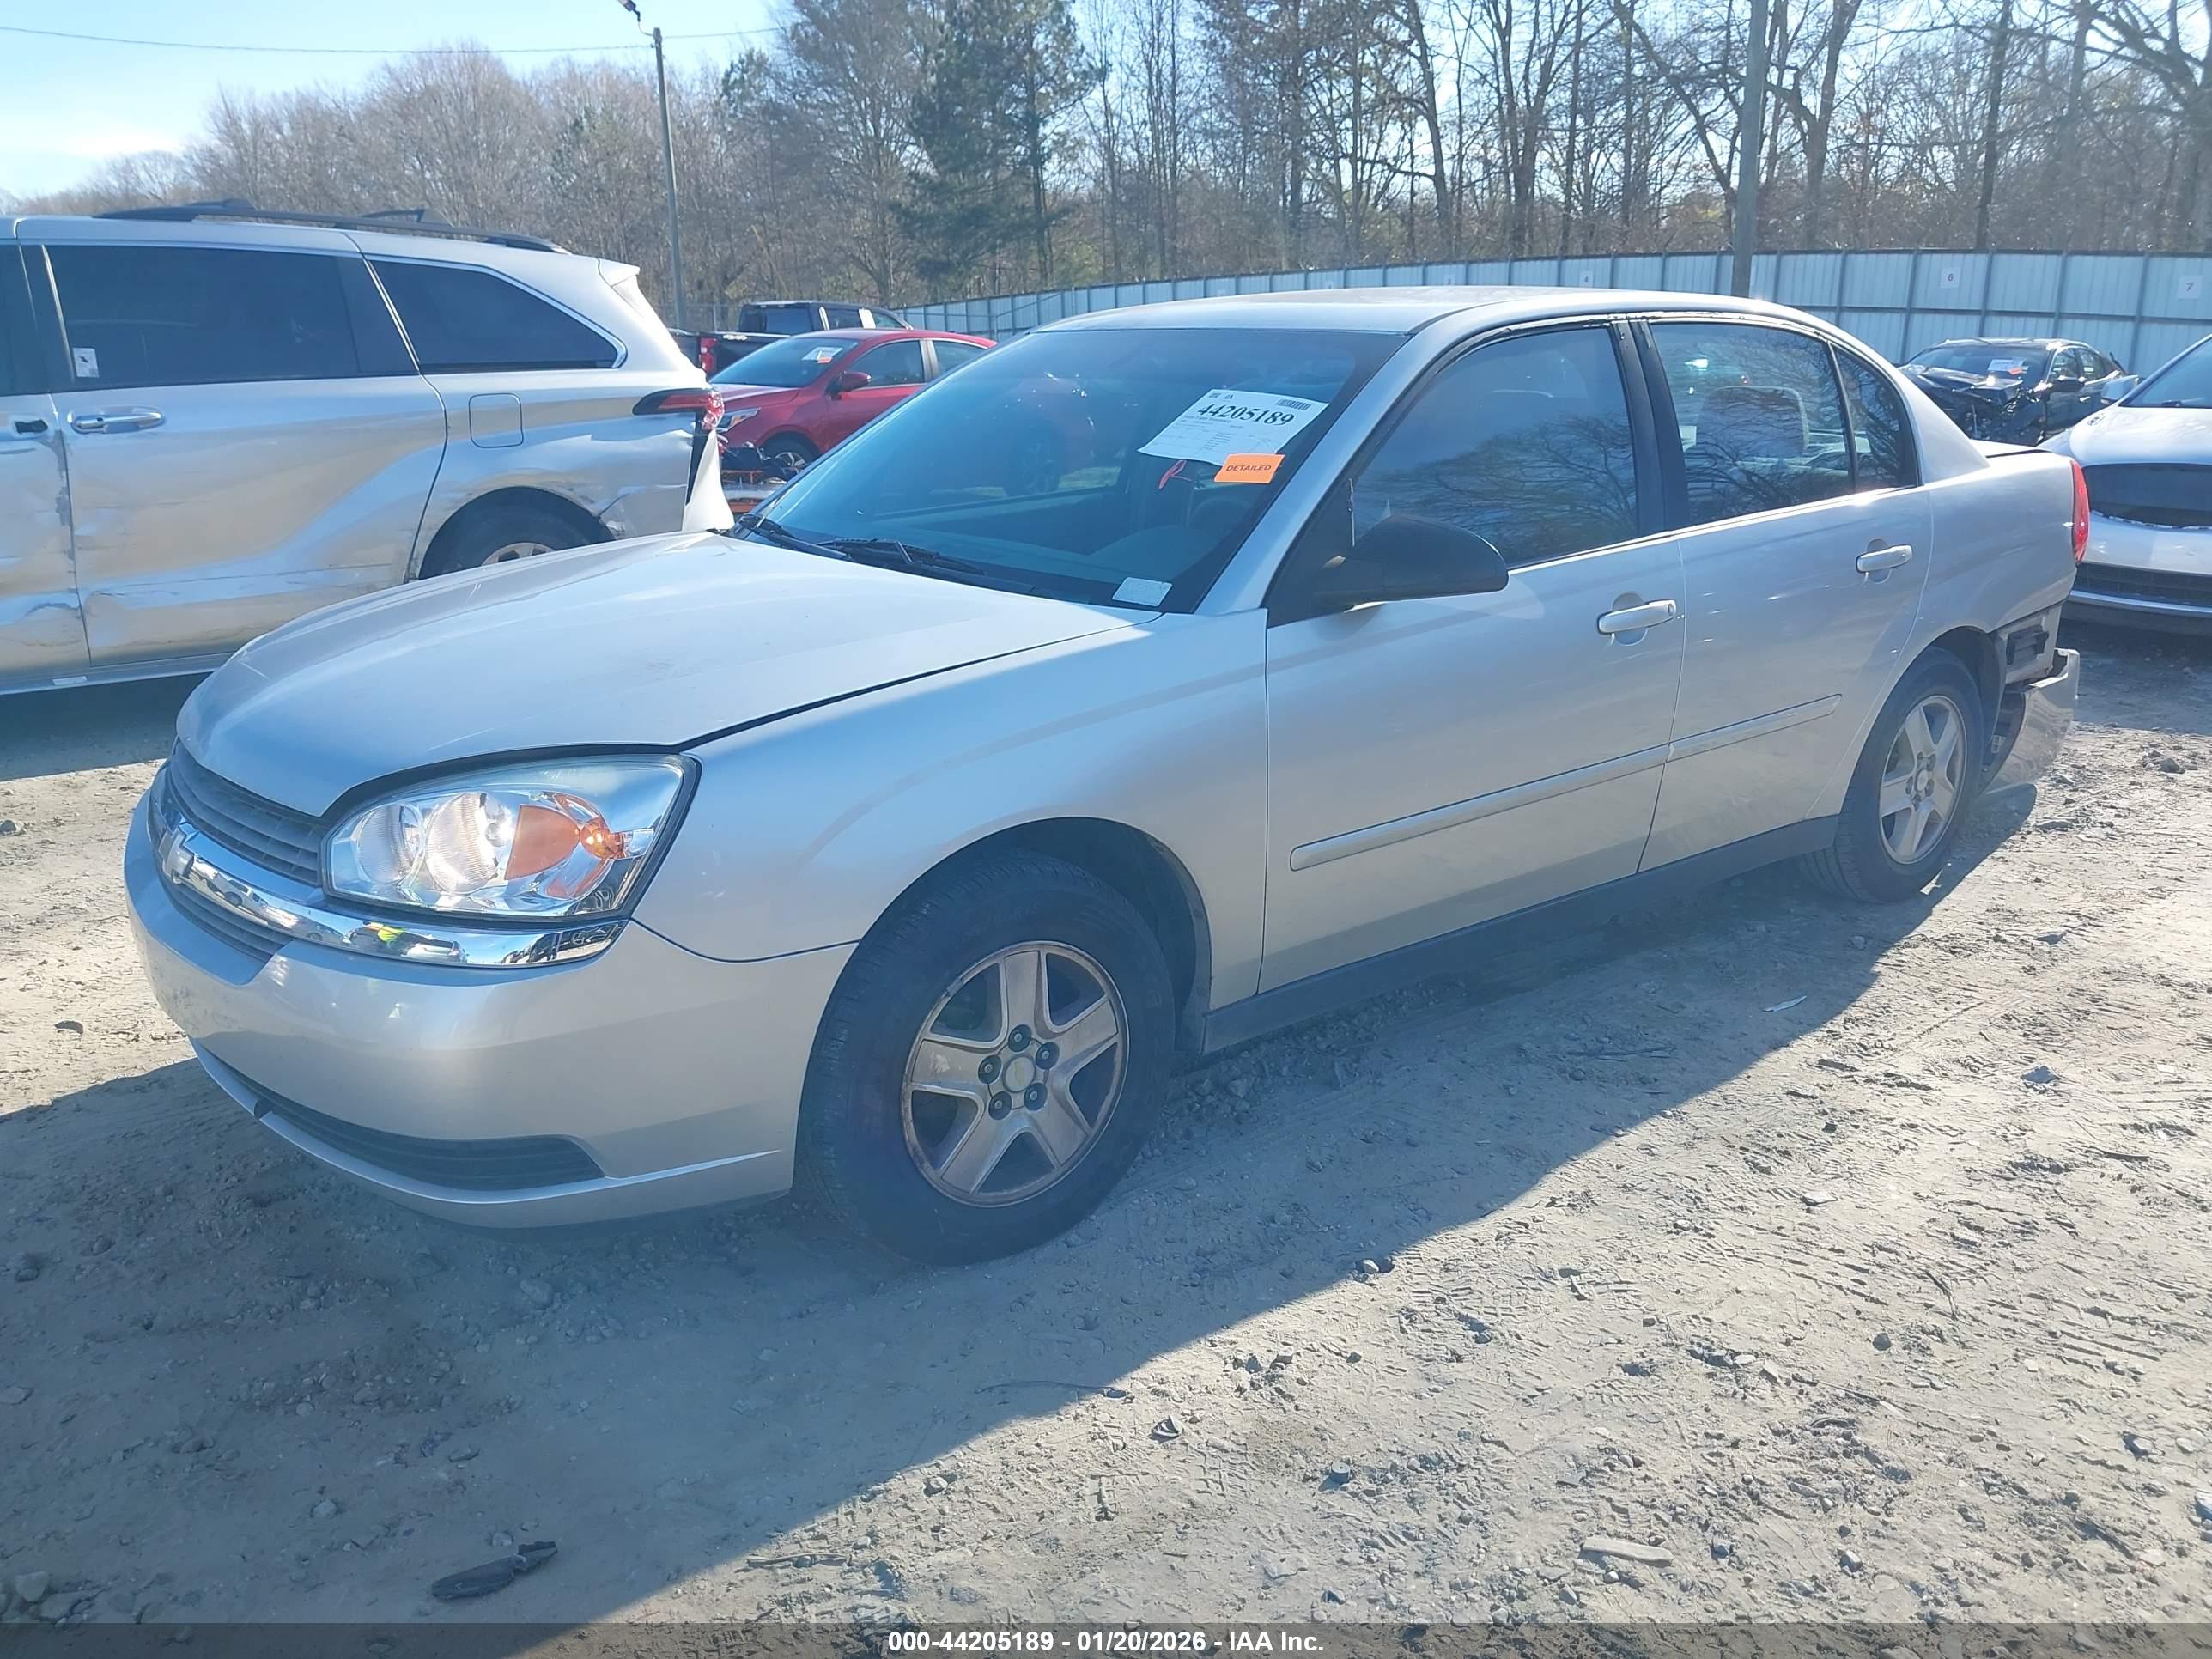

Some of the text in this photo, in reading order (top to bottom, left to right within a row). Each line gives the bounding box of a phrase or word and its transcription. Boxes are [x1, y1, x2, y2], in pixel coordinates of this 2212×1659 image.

[1947, 272, 1954, 282] 6
[2185, 281, 2194, 292] 7
[1198, 404, 1295, 426] 44205189
